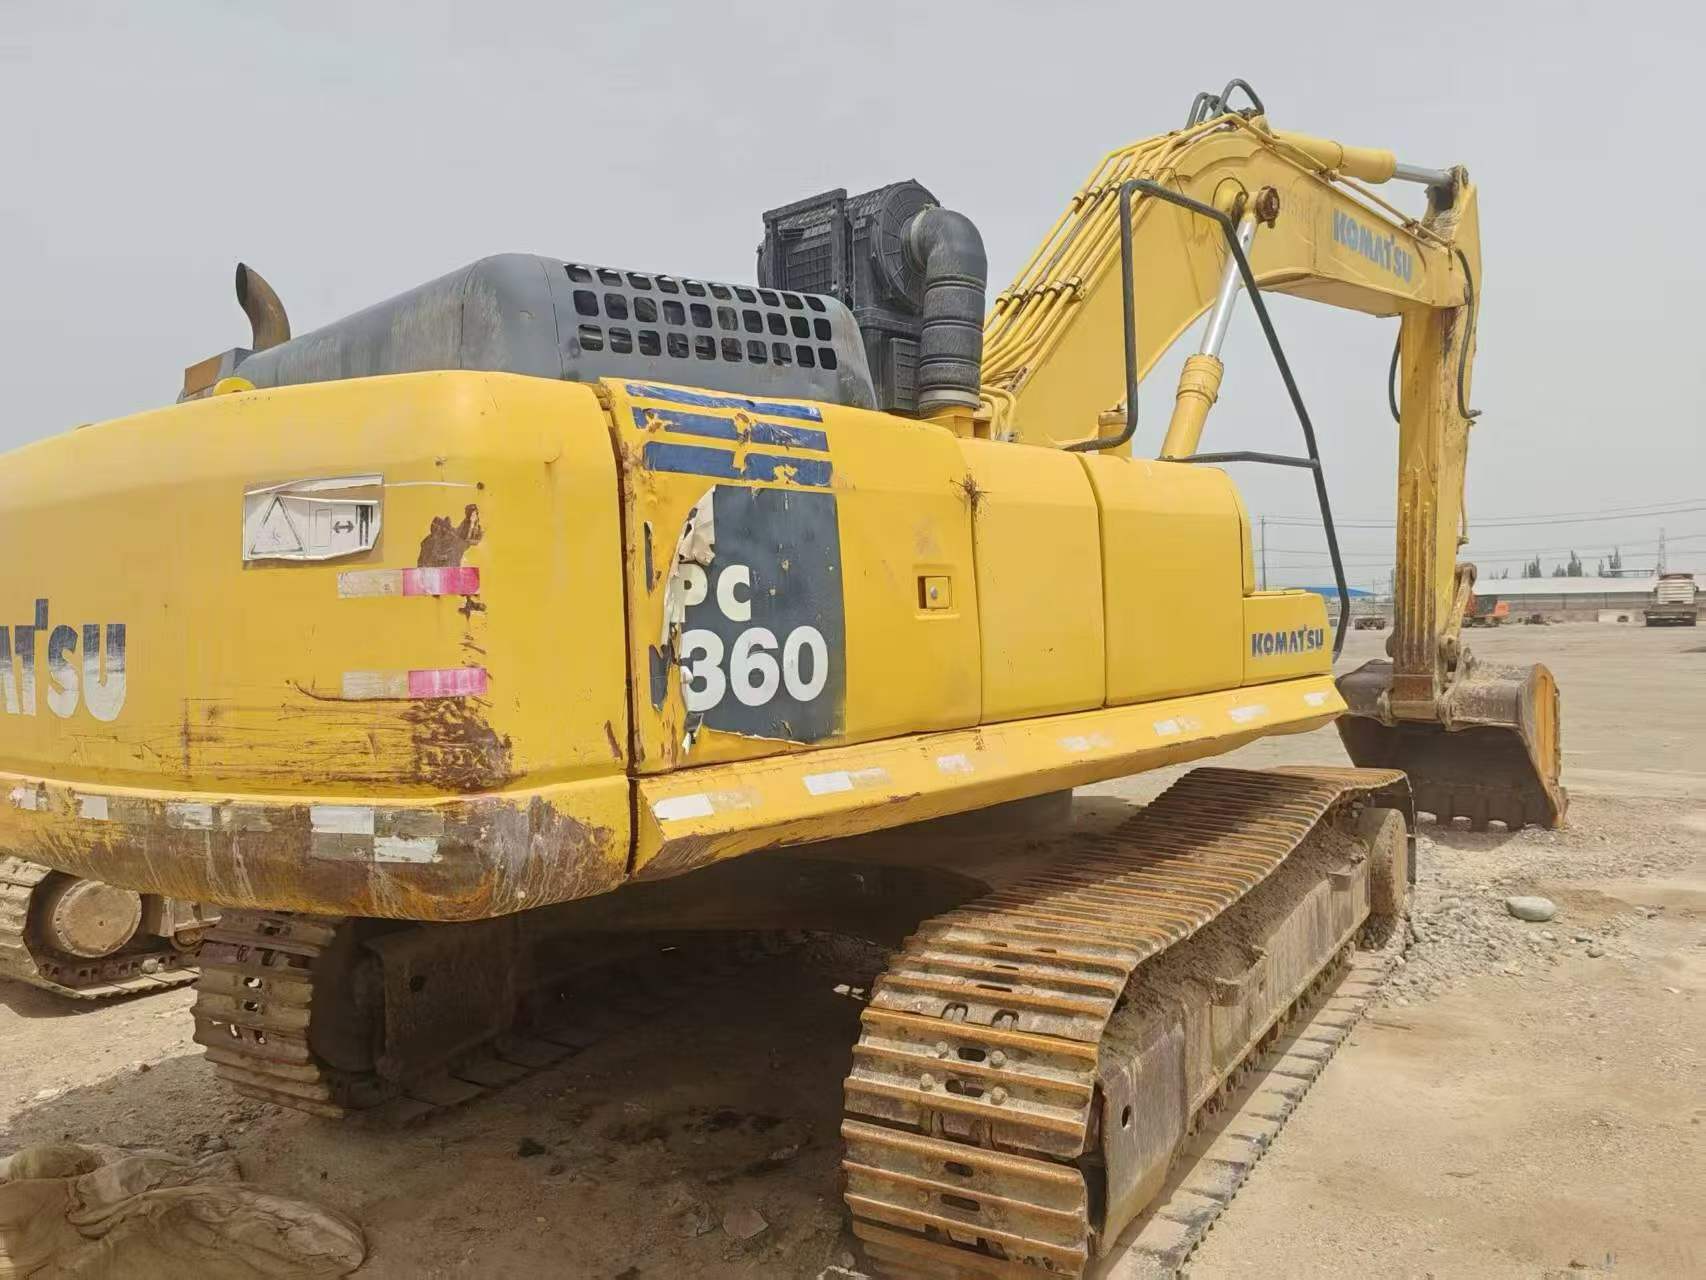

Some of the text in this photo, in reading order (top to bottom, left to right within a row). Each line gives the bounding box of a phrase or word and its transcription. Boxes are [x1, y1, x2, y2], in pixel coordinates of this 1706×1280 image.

[1333, 208, 1413, 283] KOMATSU
[670, 563, 751, 622] PC
[680, 625, 829, 711] 360
[1251, 624, 1324, 657] KOMATSU
